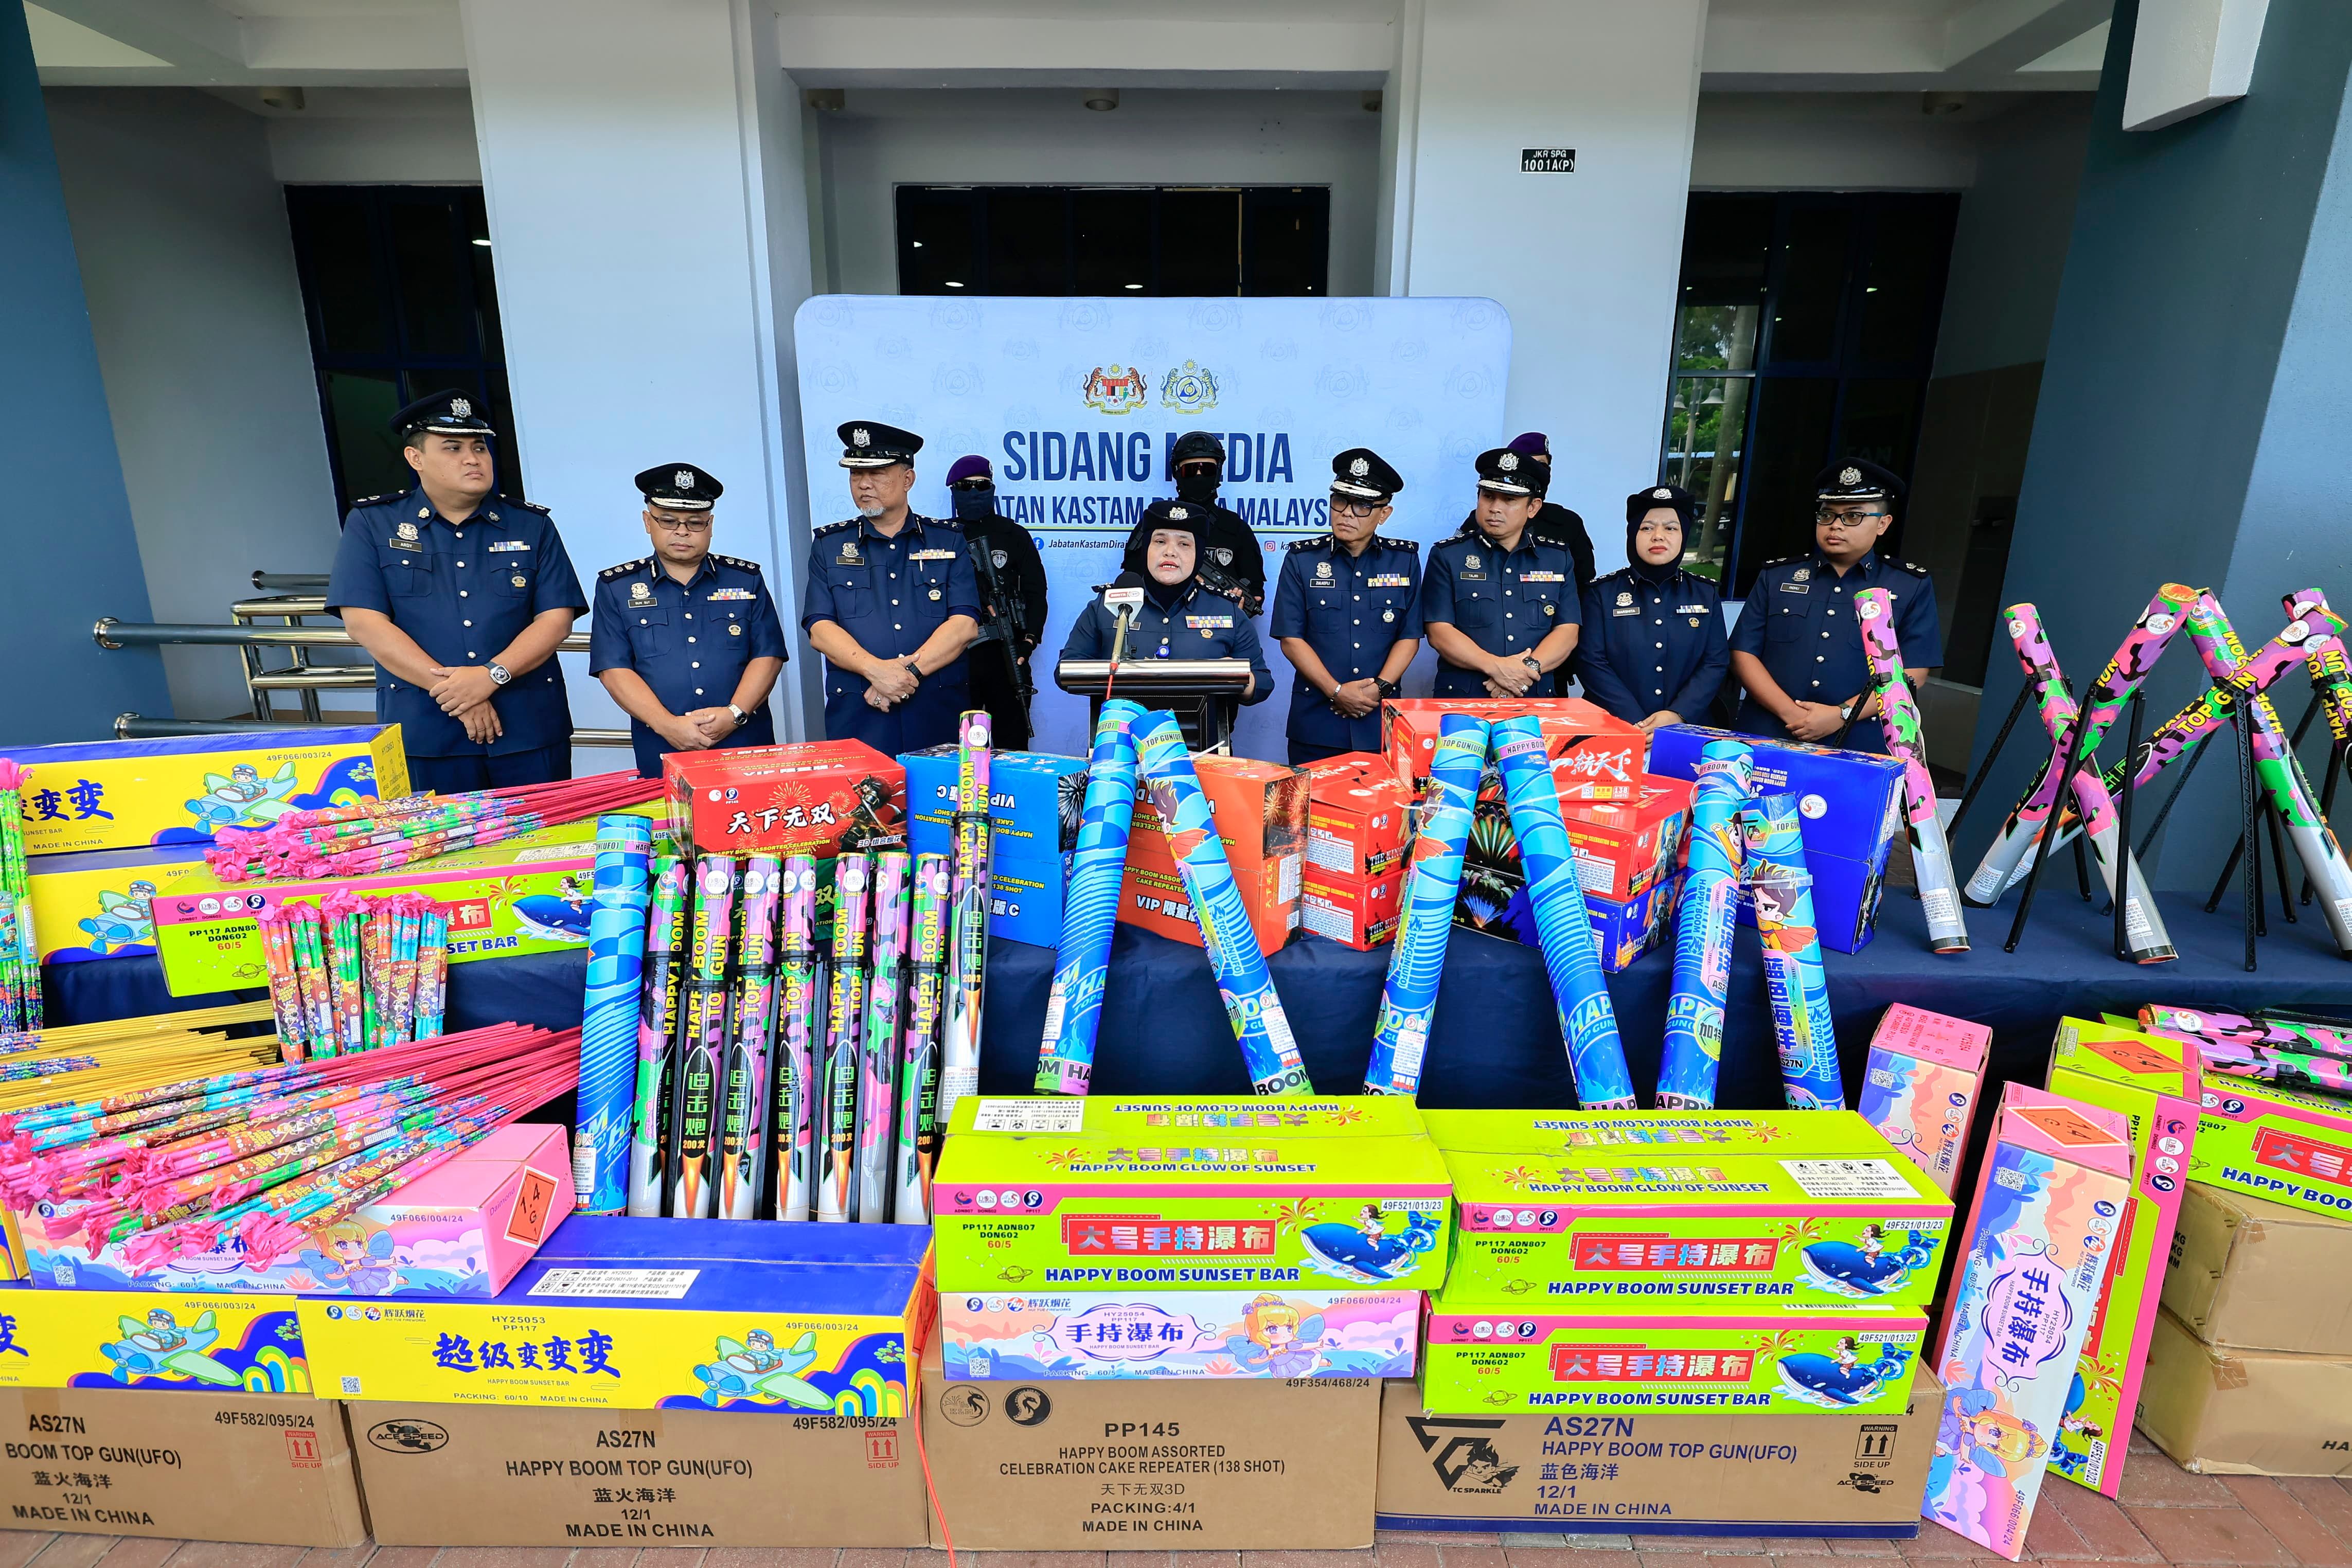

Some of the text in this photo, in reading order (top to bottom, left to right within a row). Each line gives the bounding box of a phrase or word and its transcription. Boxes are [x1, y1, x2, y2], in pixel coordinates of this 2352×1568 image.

[1524, 159, 1574, 171] 1001A(P)
[1003, 431, 1150, 481] SIDANG
[1053, 496, 1142, 524] KASTAM
[2198, 620, 2218, 631] ADN801
[2176, 703, 2214, 734] TOP
[1507, 742, 1530, 754] HAPPY
[266, 751, 332, 761] 49F066/003/24
[990, 793, 1016, 808] VIP
[727, 802, 836, 835] 天下无双
[74, 839, 103, 847] CHINA
[755, 844, 787, 852] ASSORTED
[788, 839, 830, 849] CELEBRATION
[857, 840, 869, 848] 3D
[977, 821, 989, 860] TOP
[959, 821, 974, 879] HAPPY
[1369, 853, 1385, 866] THE
[999, 876, 1045, 889] CELEBRATION
[1005, 885, 1023, 894] SHOT
[1136, 895, 1161, 911] VIP
[208, 933, 247, 941] DON602
[693, 911, 709, 969] BOOM
[217, 941, 241, 950] 60/5
[709, 935, 727, 976] GUN
[1399, 933, 1416, 988] TOP GUN(UFO)
[831, 970, 847, 1033] HAPPY
[849, 975, 863, 1013] TOP
[664, 969, 680, 1035] HAPPY
[1107, 1148, 1279, 1162] 大号手持瀑布
[1070, 1163, 1316, 1172] HAPPY BOOM GLOW OF SUNSET
[2221, 1166, 2302, 1197] HAPPY
[1382, 1201, 1442, 1210] 49F521/013/23
[390, 1214, 463, 1223] 49F066/004/24
[529, 1210, 537, 1224] G
[1885, 1221, 1943, 1230] 49F521/013/23
[988, 1240, 1011, 1249] 60/5
[1078, 1226, 1271, 1250] 大号手持瀑布
[1583, 1243, 1774, 1267] 大号手持瀑布
[1045, 1268, 1299, 1282] HAPPY BOOM SUNSET BAR
[185, 1302, 256, 1310] 49F066/003/24
[1328, 1296, 1401, 1305] 49F066/004/24
[492, 1315, 546, 1324] HY25053
[2001, 1267, 2051, 1368] 手持瀑布
[786, 1322, 859, 1331] 49F066/003/24
[1065, 1322, 1184, 1343] 手持瀑布
[2044, 1309, 2060, 1345] HY25054
[1860, 1333, 1916, 1342] 49F521/013/23
[432, 1329, 621, 1378] 超级变变变
[1564, 1354, 1750, 1377] 大号手持瀑布
[1286, 1379, 1370, 1388] 49F354/468/24
[29, 1415, 86, 1434] AS27N
[215, 1411, 315, 1429] 49F582/095/24
[1544, 1416, 1634, 1437] AS27N
[1104, 1422, 1180, 1437] PP145
[596, 1430, 656, 1448] AS27N
[6, 1443, 182, 1469] BOOM TOP GUN(UFO)
[1059, 1445, 1225, 1459] HAPPY BOOM ASSORTED
[1542, 1441, 1797, 1464] HAPPY BOOM TOP GUN(UFO)
[506, 1459, 753, 1479] HAPPY BOOM TOP GUN(UFO)
[1000, 1459, 1285, 1475] CELEBRATION CAKE REPEATER (138 SHOT)
[1539, 1463, 1619, 1481] 蓝色海洋
[32, 1471, 113, 1489] 蓝火海洋
[593, 1488, 676, 1503] 蓝火海洋
[1101, 1483, 1185, 1495] 天下无双3D
[62, 1492, 92, 1505] 12/1
[1091, 1502, 1196, 1513] PACKING:4/1
[2002, 1489, 2027, 1546] 49F066/004/24
